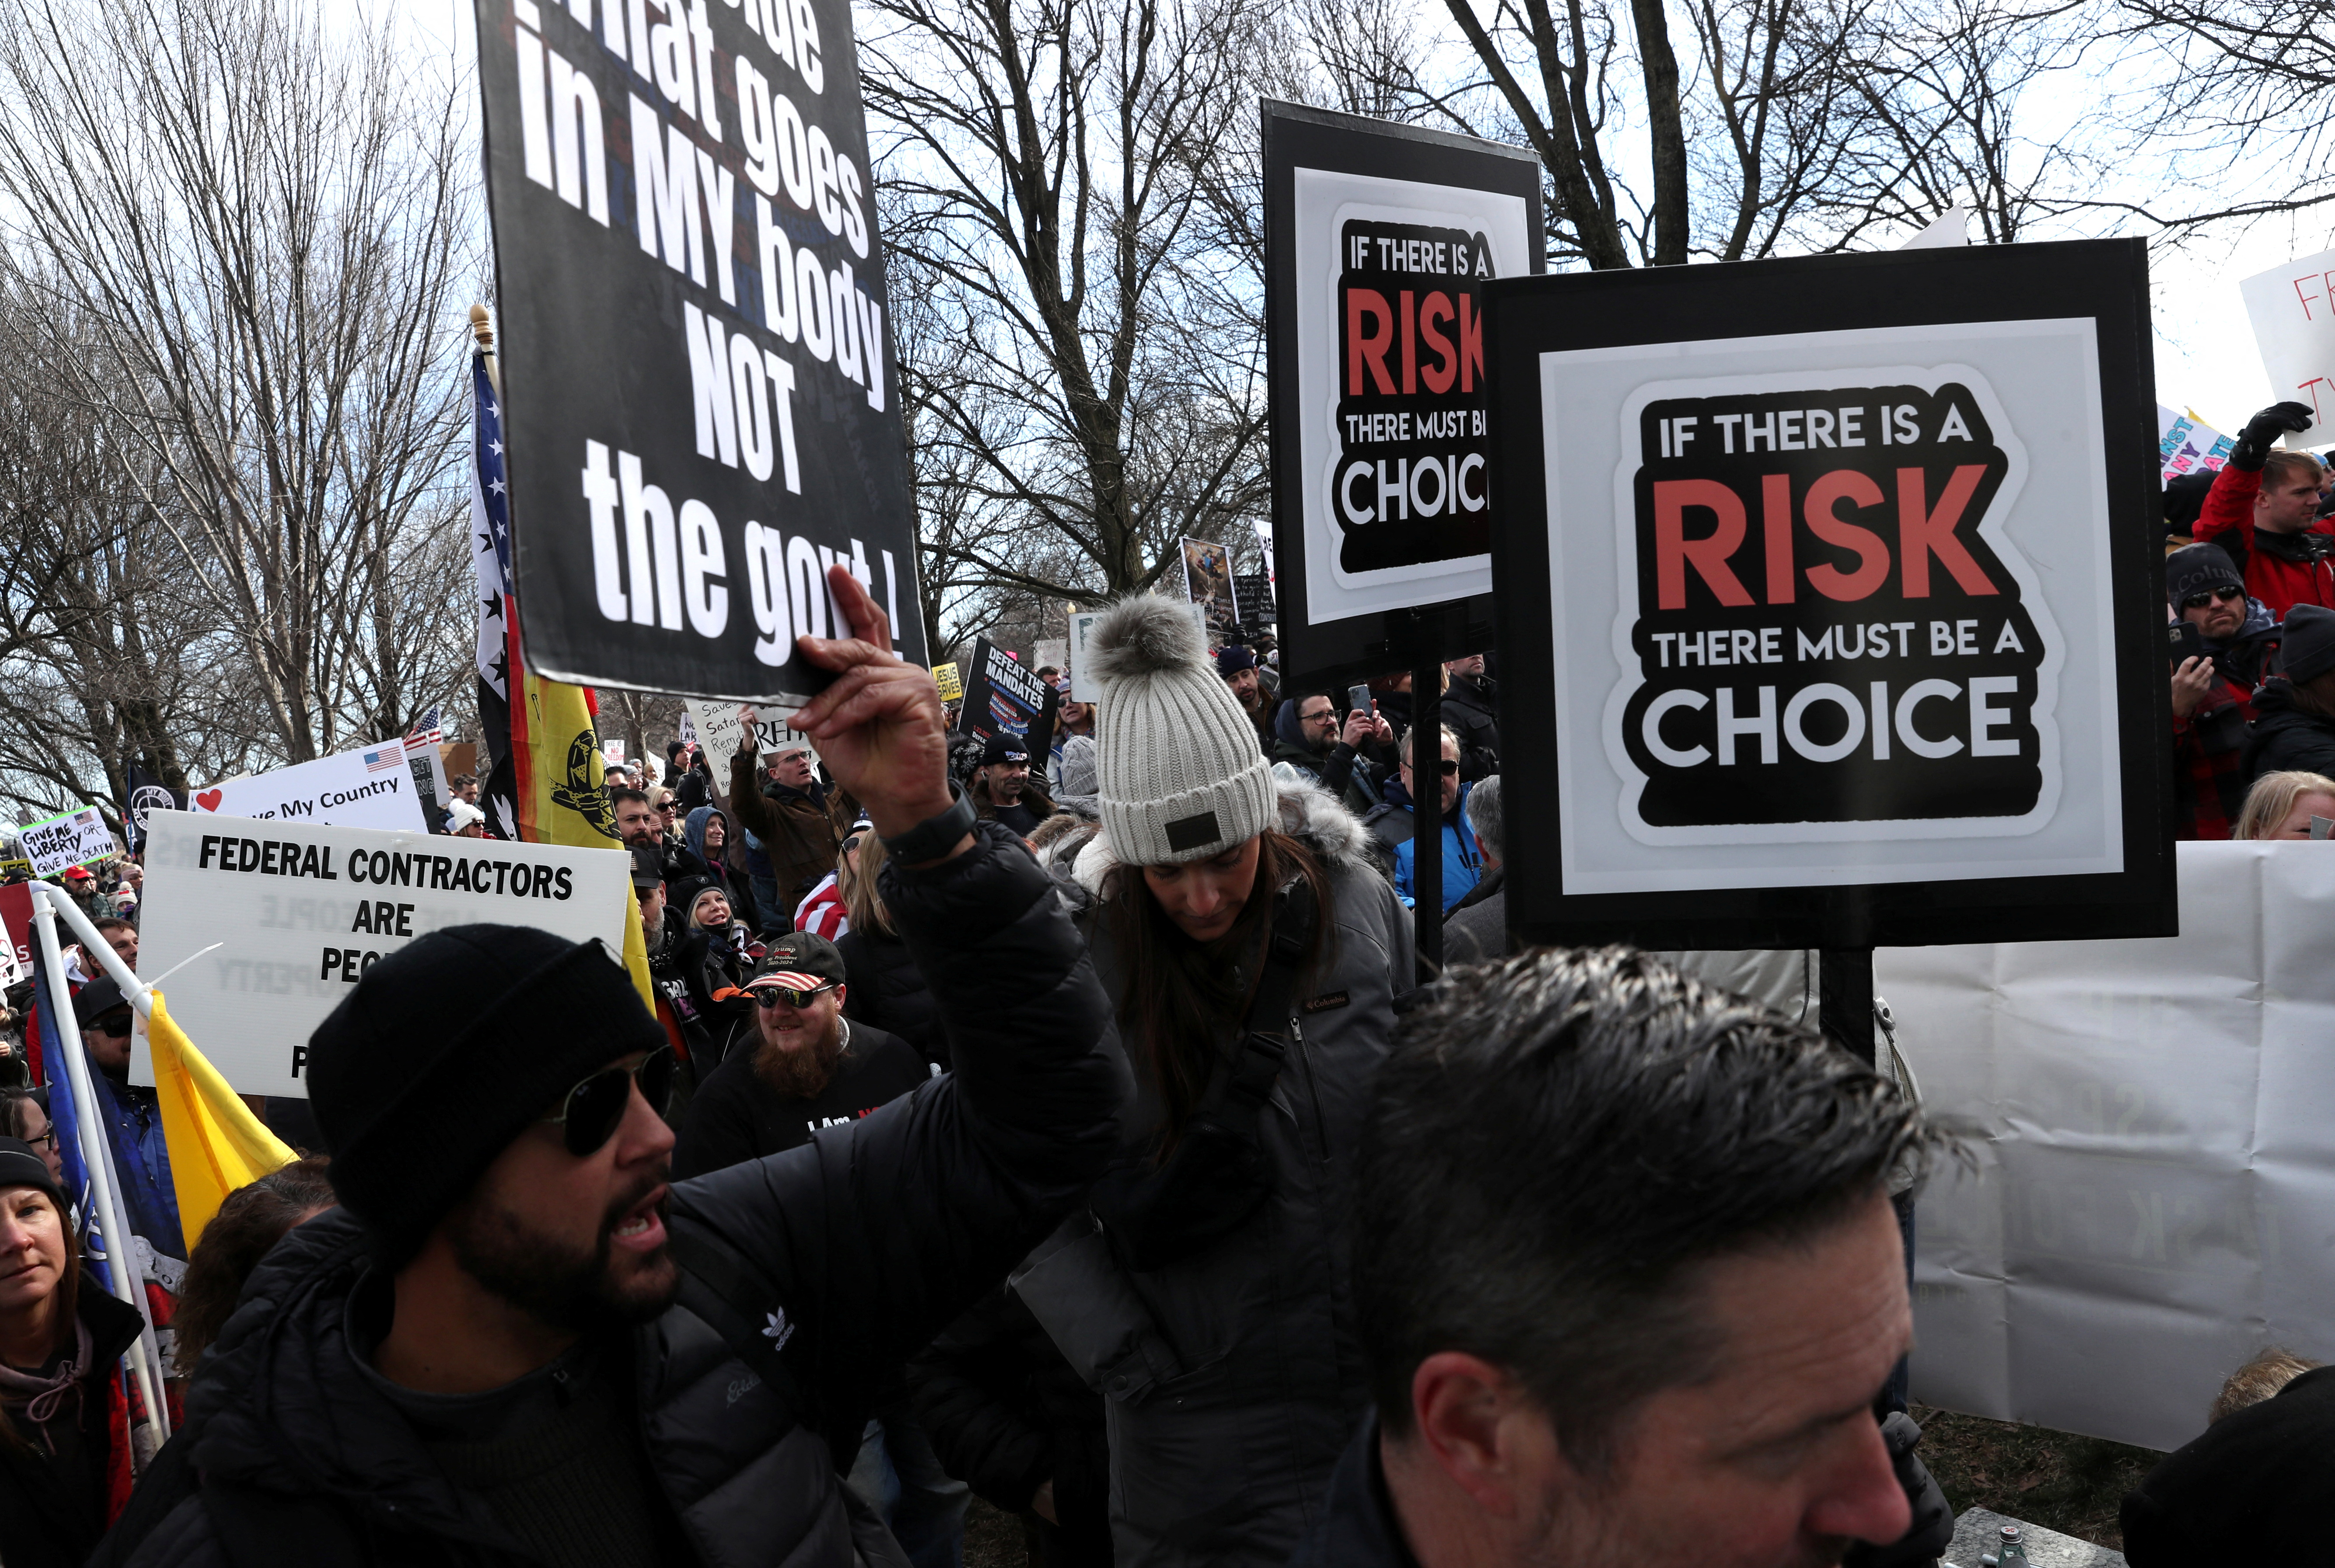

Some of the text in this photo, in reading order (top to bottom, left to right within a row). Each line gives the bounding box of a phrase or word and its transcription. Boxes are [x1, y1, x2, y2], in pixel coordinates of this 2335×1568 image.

[735, 55, 868, 259] goes
[514, 0, 610, 228] in
[628, 91, 735, 307] MY
[755, 191, 884, 413] body
[1350, 235, 1489, 277] IF THERE IS A
[685, 300, 801, 496] NOT
[1346, 413, 1410, 444] THERE
[1416, 411, 1466, 440] MUST
[1660, 402, 1974, 458] IF THERE IS A
[2160, 416, 2193, 468] INST
[2196, 434, 2237, 474] ATE
[1341, 453, 1490, 524] CHOIC
[582, 438, 729, 638] the
[1653, 464, 2001, 610] RISK
[1651, 618, 2025, 668] THERE MUST BE A
[936, 666, 957, 683] JESUS
[938, 681, 960, 697] SAVES
[985, 660, 1044, 711] MANDATES
[988, 645, 1046, 695] DEFEAT THE
[995, 684, 1014, 700] AMERICAN
[1014, 696, 1037, 715] HOMECOMING
[711, 730, 744, 753] Remdi
[1642, 676, 2020, 768] CHOICE
[408, 757, 431, 776] GET
[157, 791, 172, 806] BODY
[281, 777, 398, 819] My Country
[415, 778, 435, 796] ING
[22, 822, 73, 846] GIVE ME
[28, 832, 82, 860] LIBERTY
[37, 842, 113, 874] GIVE ME DEATH
[199, 835, 573, 901] FEDERAL CONTRACTORS
[351, 899, 415, 937] ARE
[321, 947, 394, 983] PEO
[1314, 996, 1346, 1008] Columbia
[775, 1323, 795, 1351] adidas
